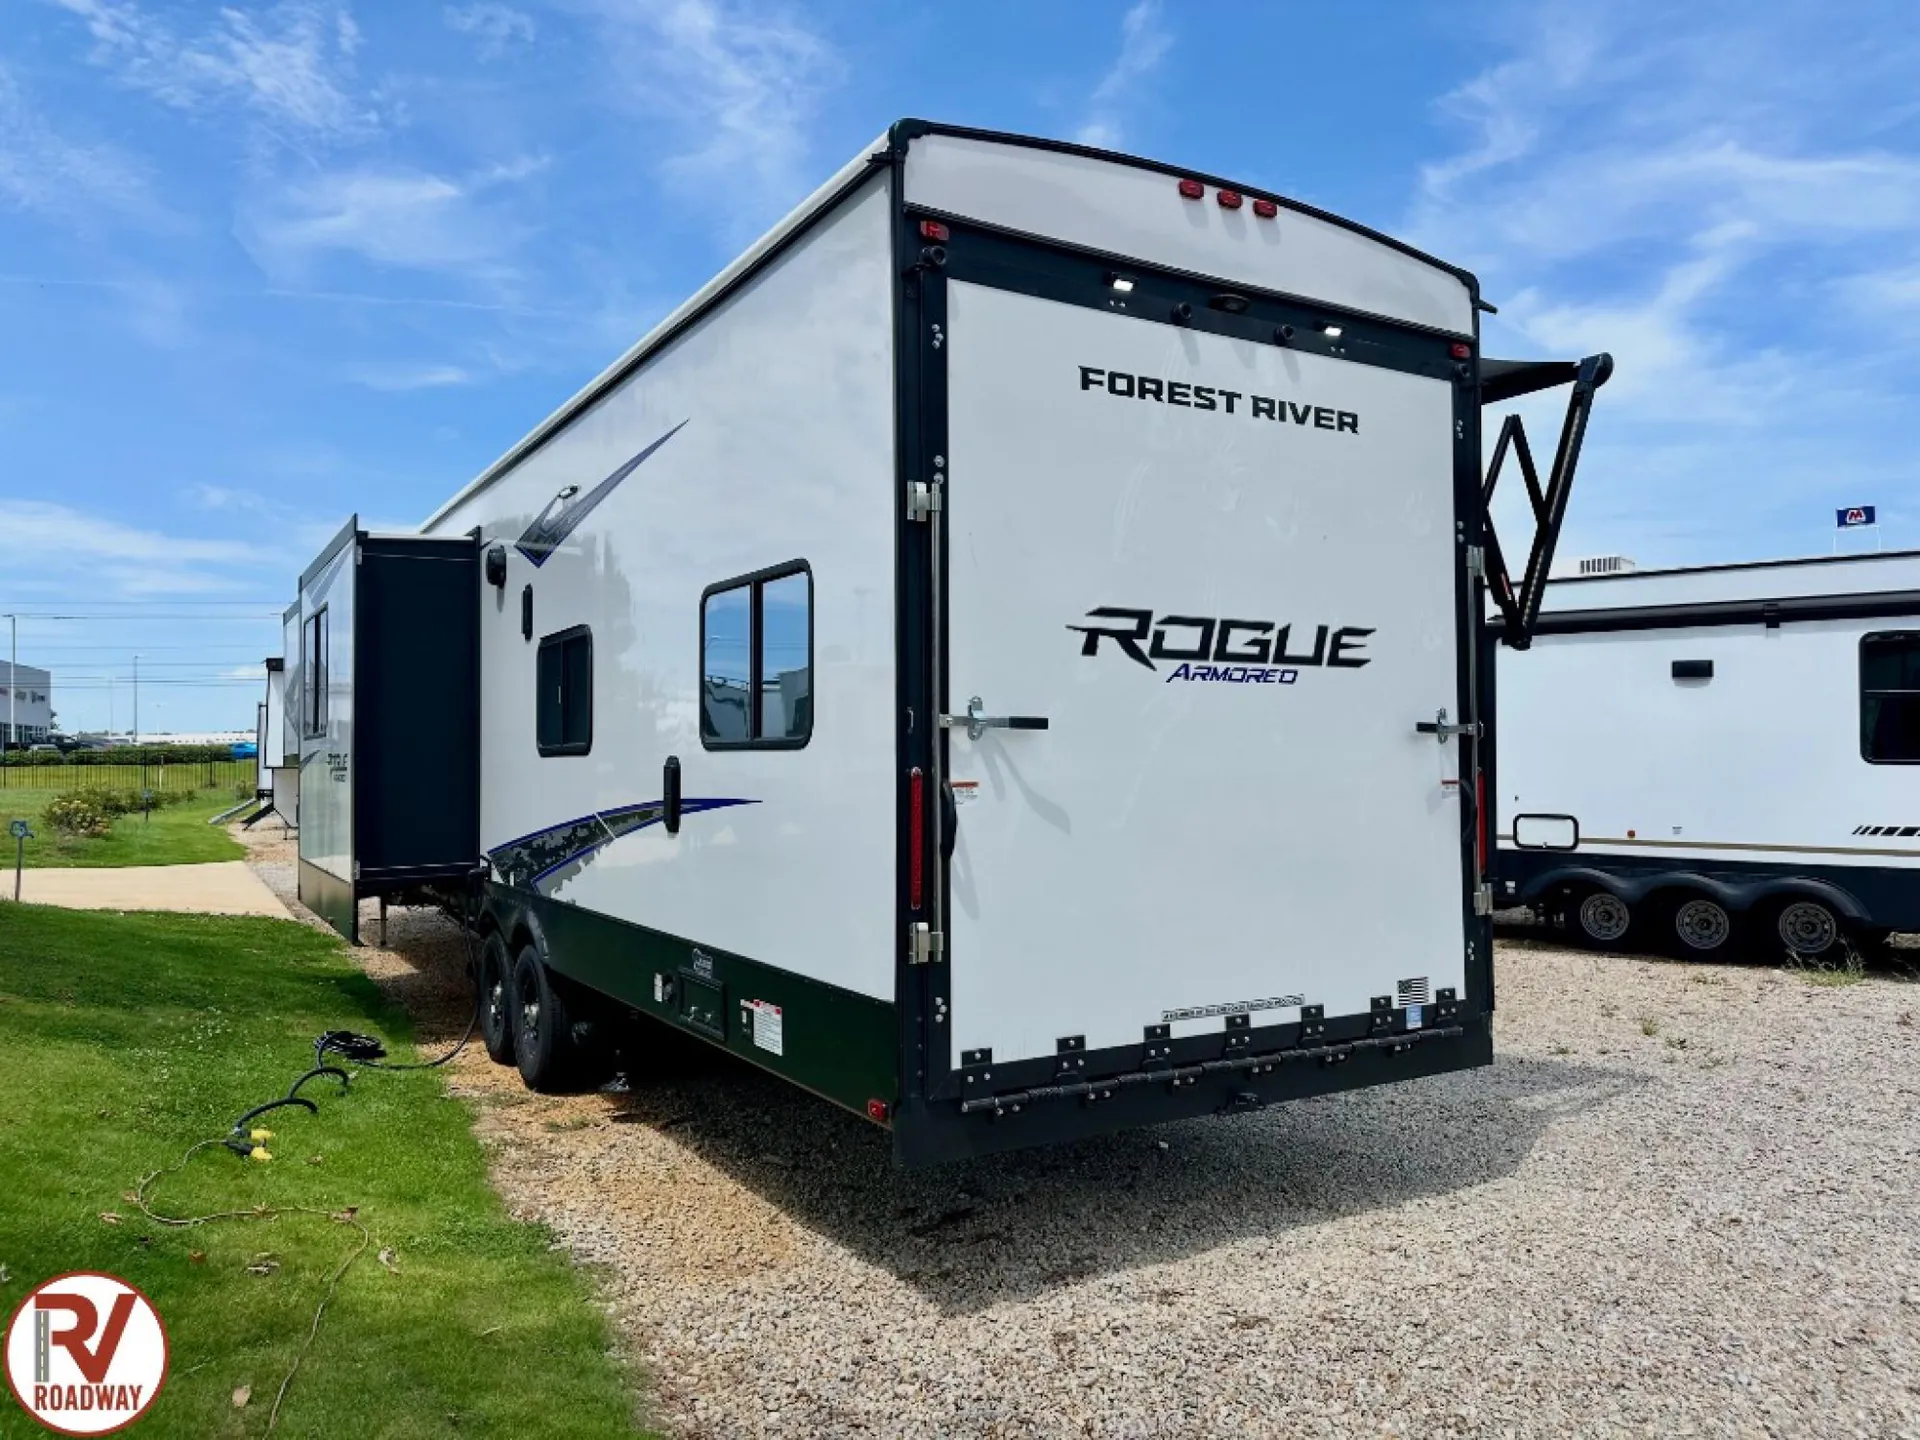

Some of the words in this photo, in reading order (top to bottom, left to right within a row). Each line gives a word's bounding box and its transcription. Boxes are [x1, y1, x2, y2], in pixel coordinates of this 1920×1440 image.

[1079, 365, 1242, 414] FOREST
[1251, 395, 1360, 435] RIVER
[1065, 607, 1377, 671] ROGUE
[1166, 663, 1298, 685] ARMORED
